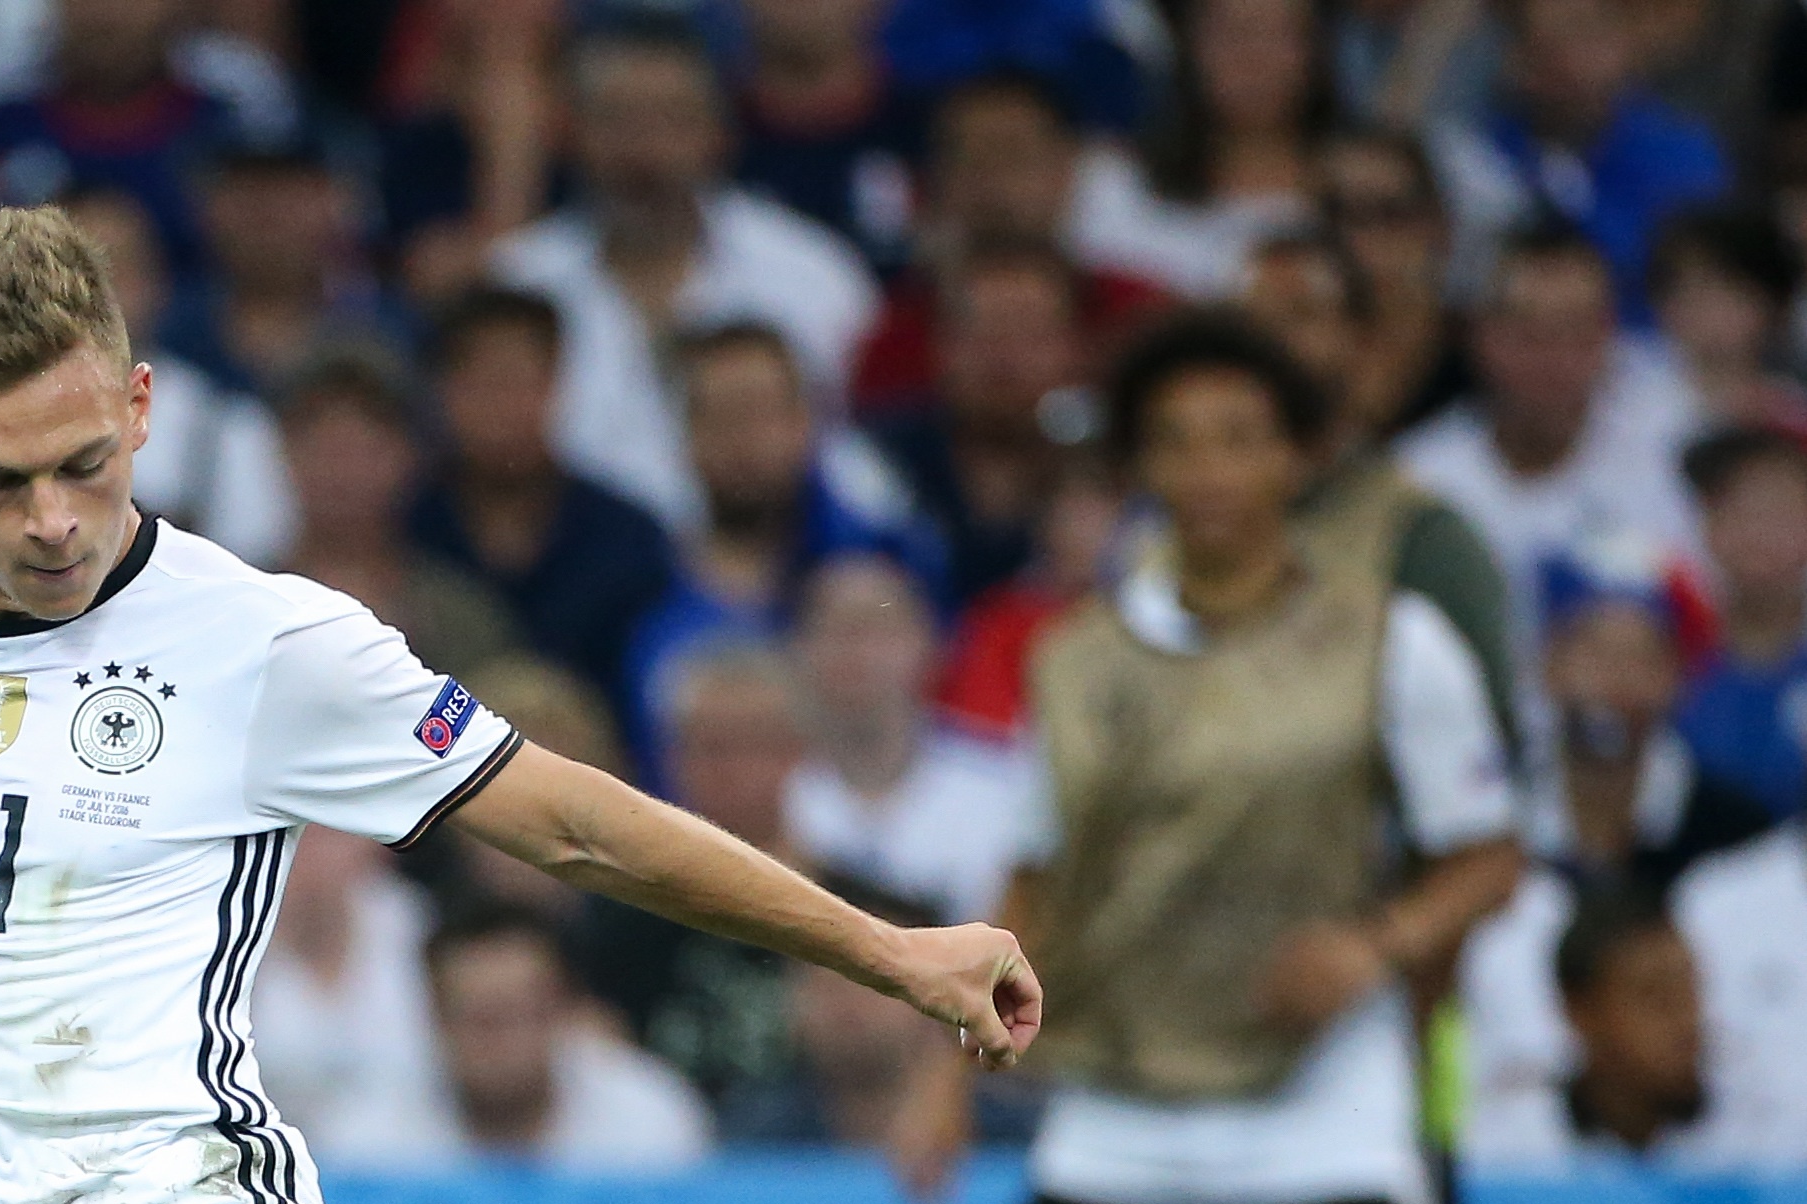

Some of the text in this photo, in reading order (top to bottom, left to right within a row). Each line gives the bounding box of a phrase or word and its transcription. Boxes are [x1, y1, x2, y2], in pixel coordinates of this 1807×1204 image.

[94, 697, 146, 717] DEUTSCHER
[62, 784, 151, 806] GERMANY VS FRANCE
[58, 808, 86, 822] STADE
[76, 799, 129, 816] 07 JULY 2016
